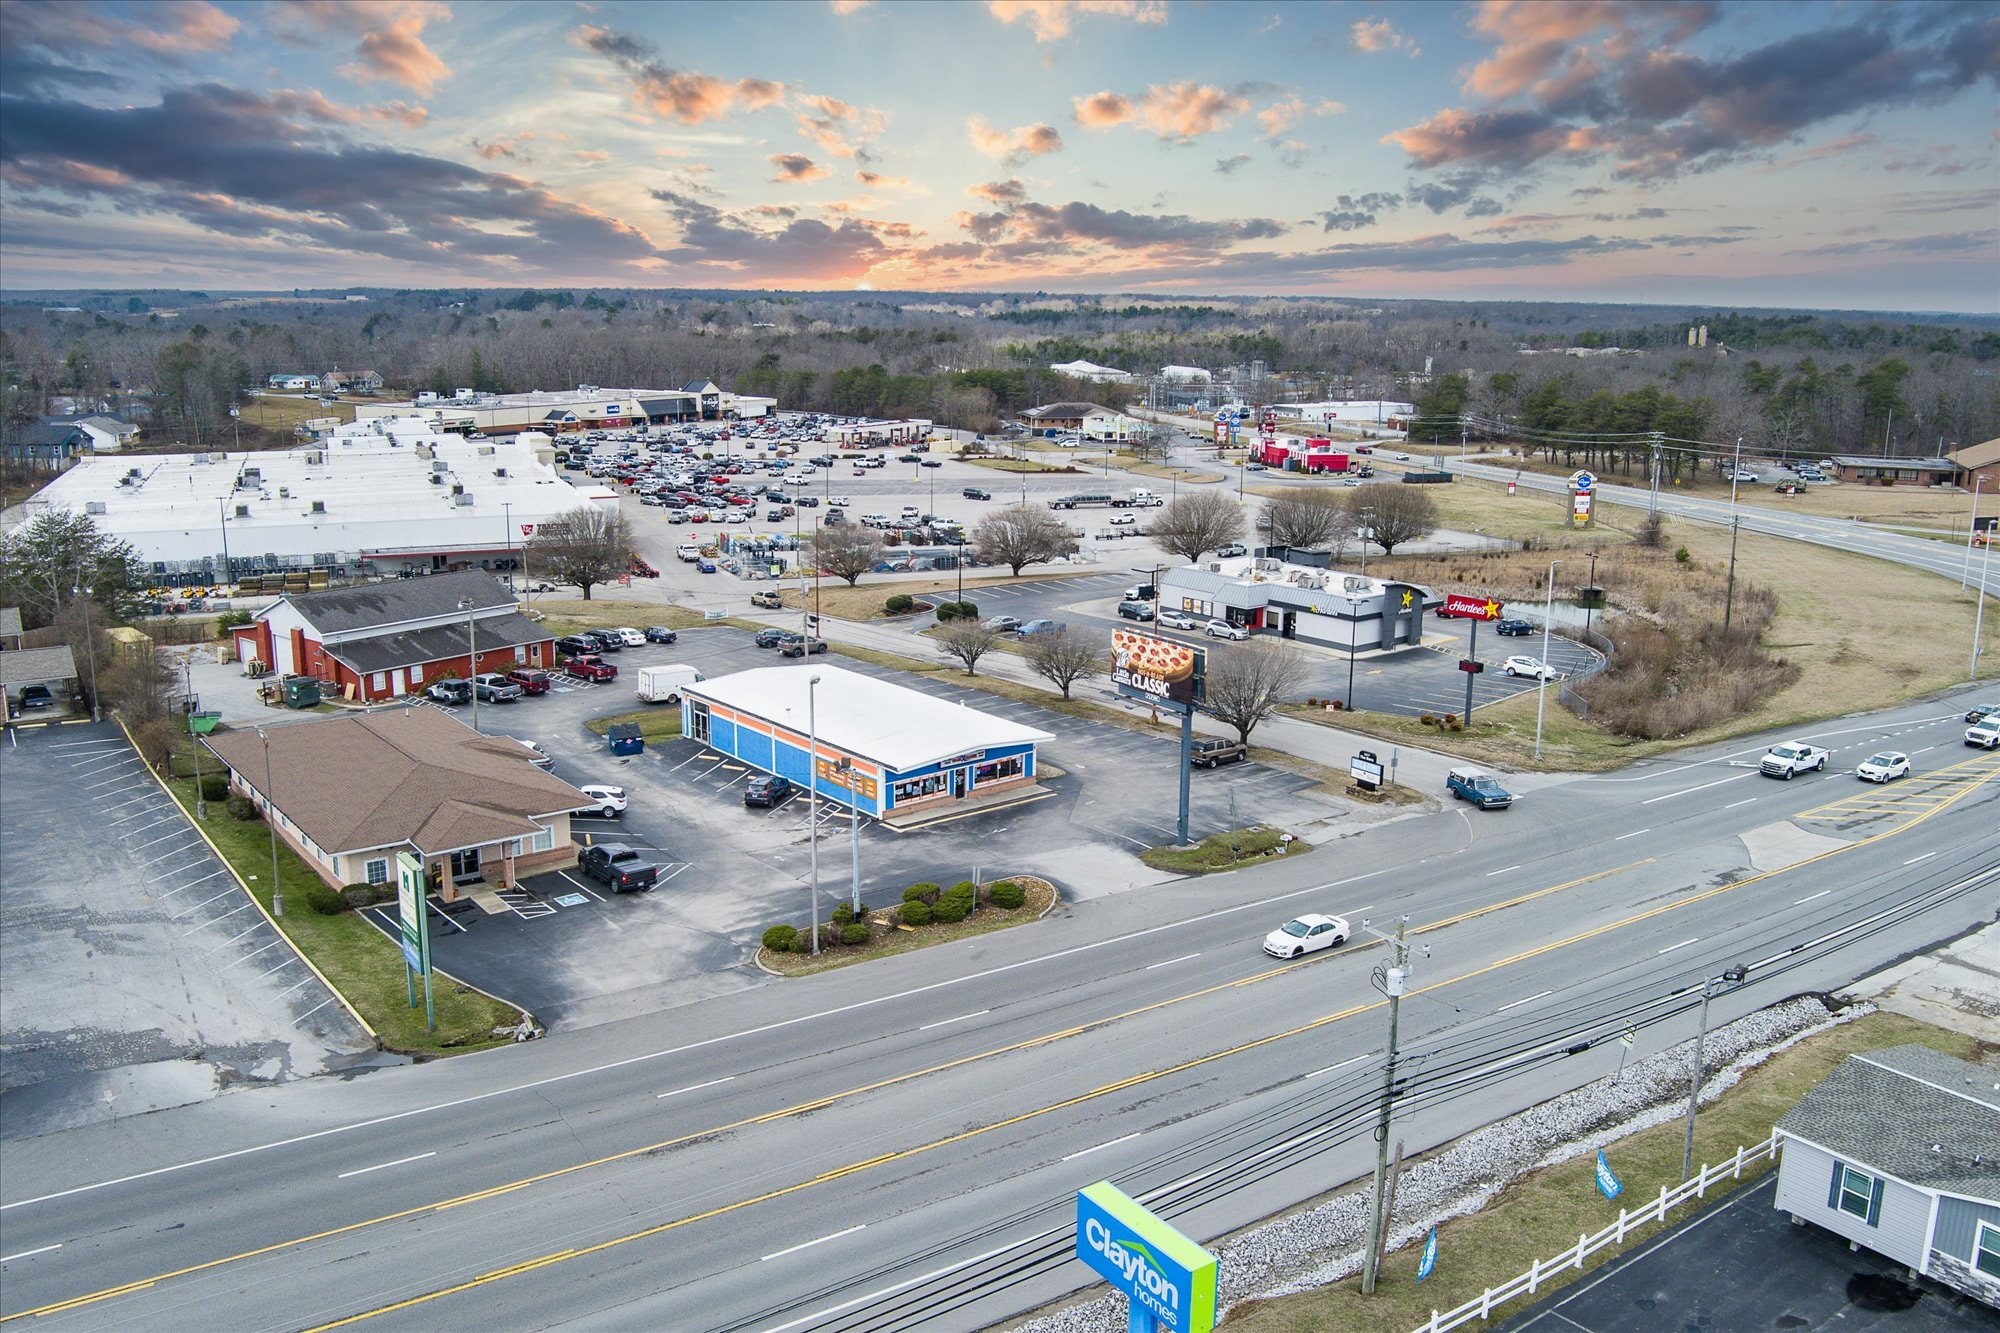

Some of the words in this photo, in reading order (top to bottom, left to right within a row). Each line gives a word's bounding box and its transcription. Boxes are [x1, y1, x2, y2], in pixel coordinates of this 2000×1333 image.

[1115, 667, 1130, 679] Little
[1132, 673, 1170, 697] CLASSIC
[1086, 1217, 1178, 1310] Clayton
[1134, 1280, 1177, 1326] homes
